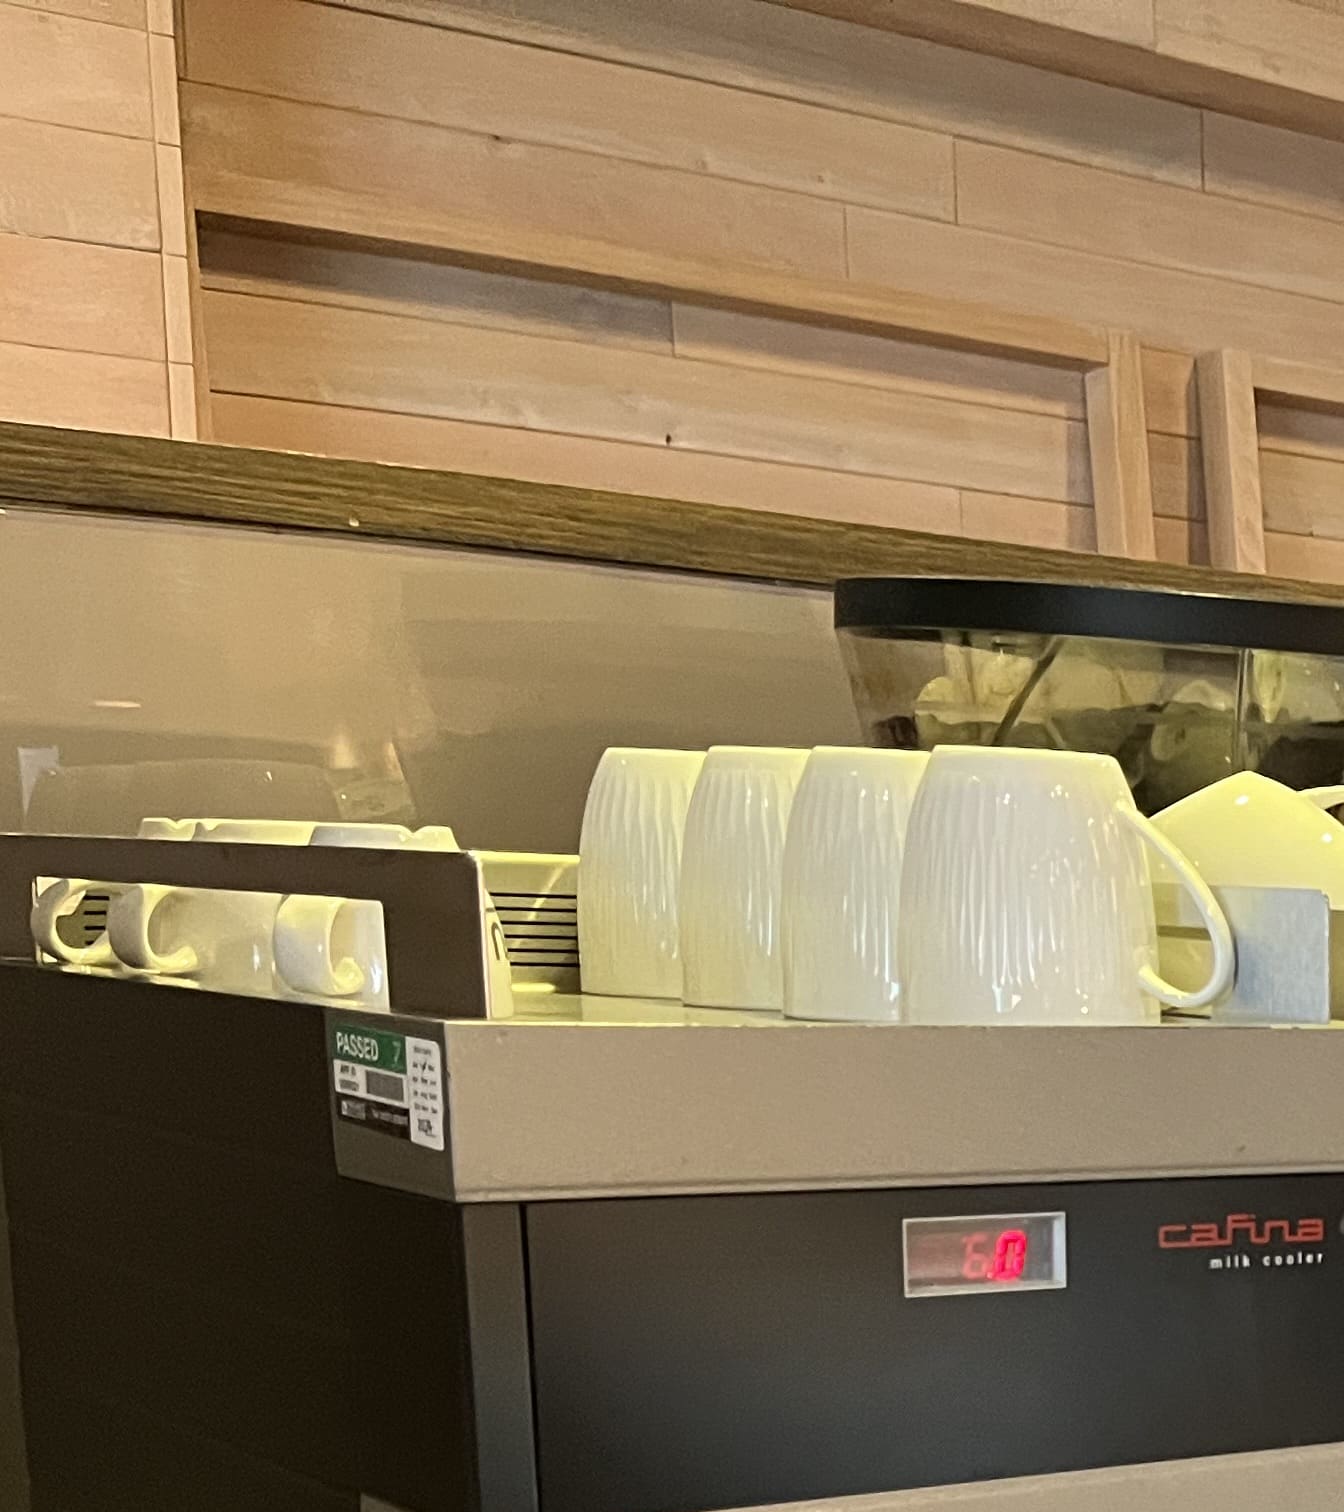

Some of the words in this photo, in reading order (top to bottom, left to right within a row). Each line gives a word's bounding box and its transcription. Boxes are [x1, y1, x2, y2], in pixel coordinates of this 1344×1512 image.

[335, 1031, 379, 1061] PASSED
[1158, 1213, 1324, 1248] cafina
[1209, 1254, 1251, 1269] milk
[1262, 1251, 1324, 1267] cooler
